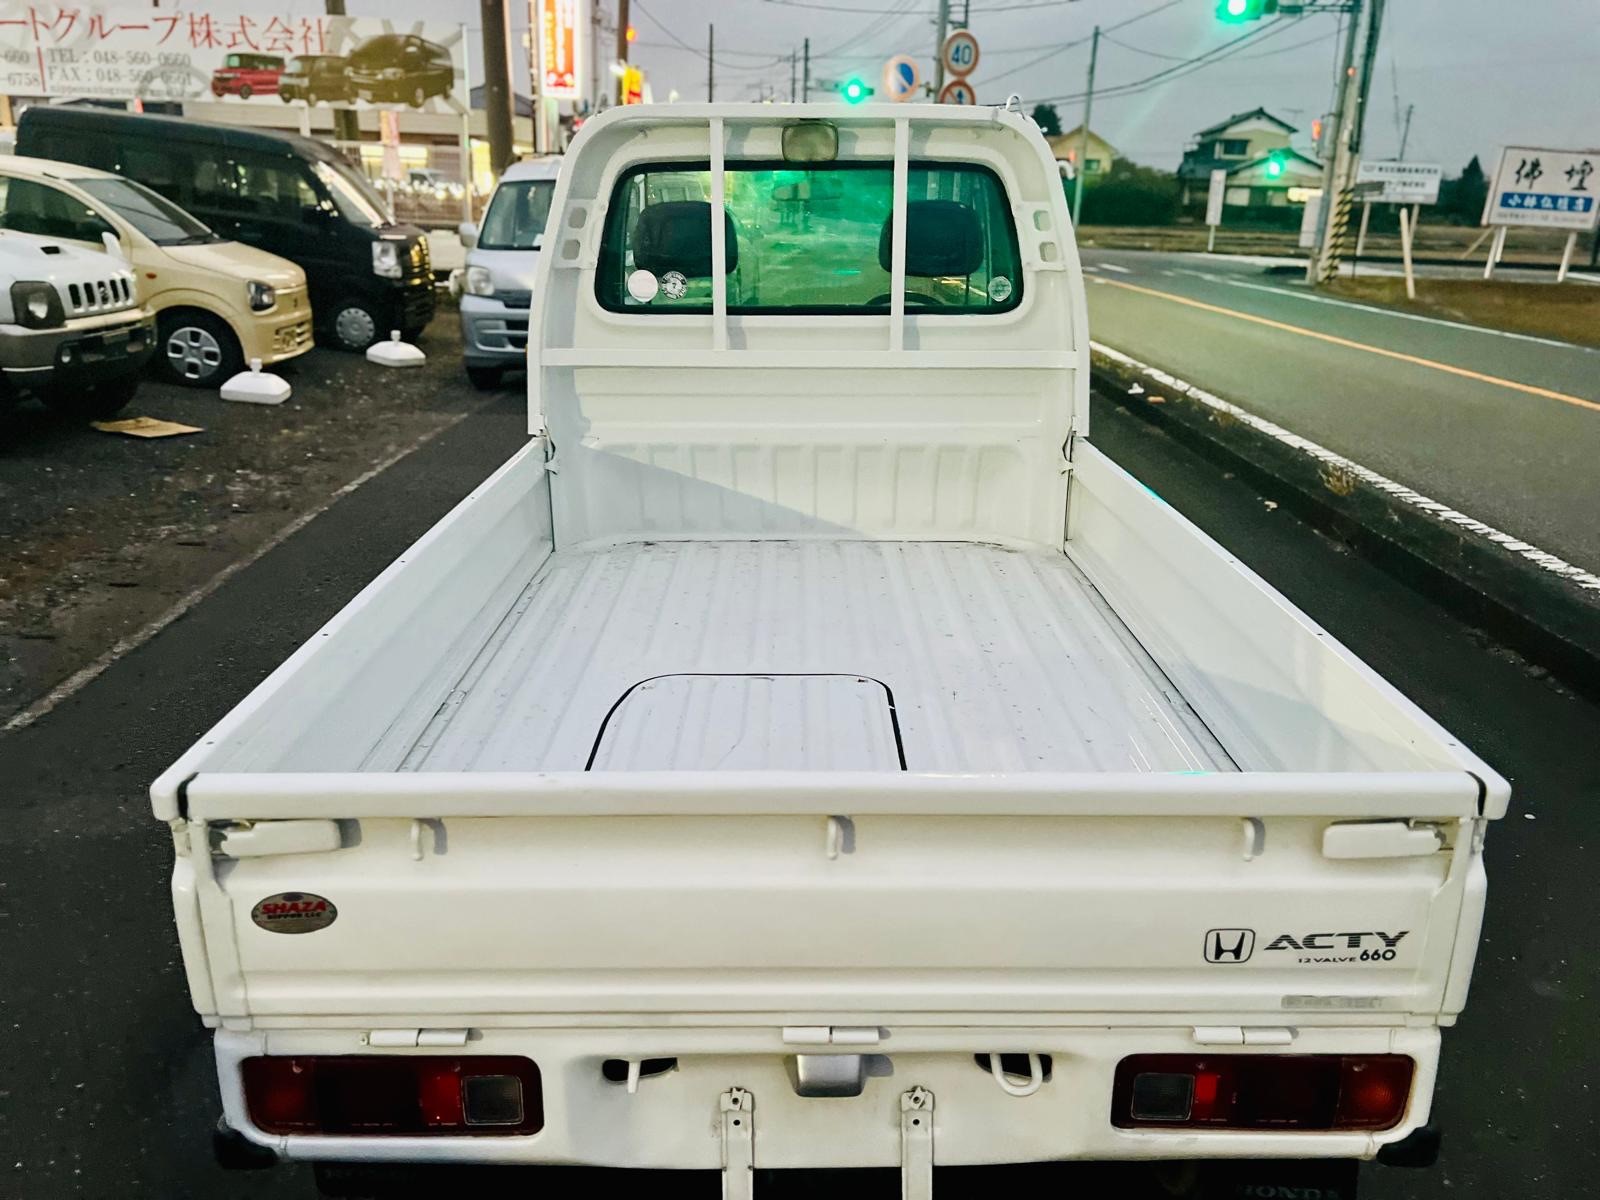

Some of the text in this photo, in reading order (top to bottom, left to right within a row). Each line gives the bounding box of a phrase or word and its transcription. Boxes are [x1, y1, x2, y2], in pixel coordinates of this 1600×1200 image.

[952, 45, 972, 65] 40
[261, 901, 327, 914] SHAZA
[1264, 930, 1410, 951] ACTY
[1359, 949, 1397, 962] 660
